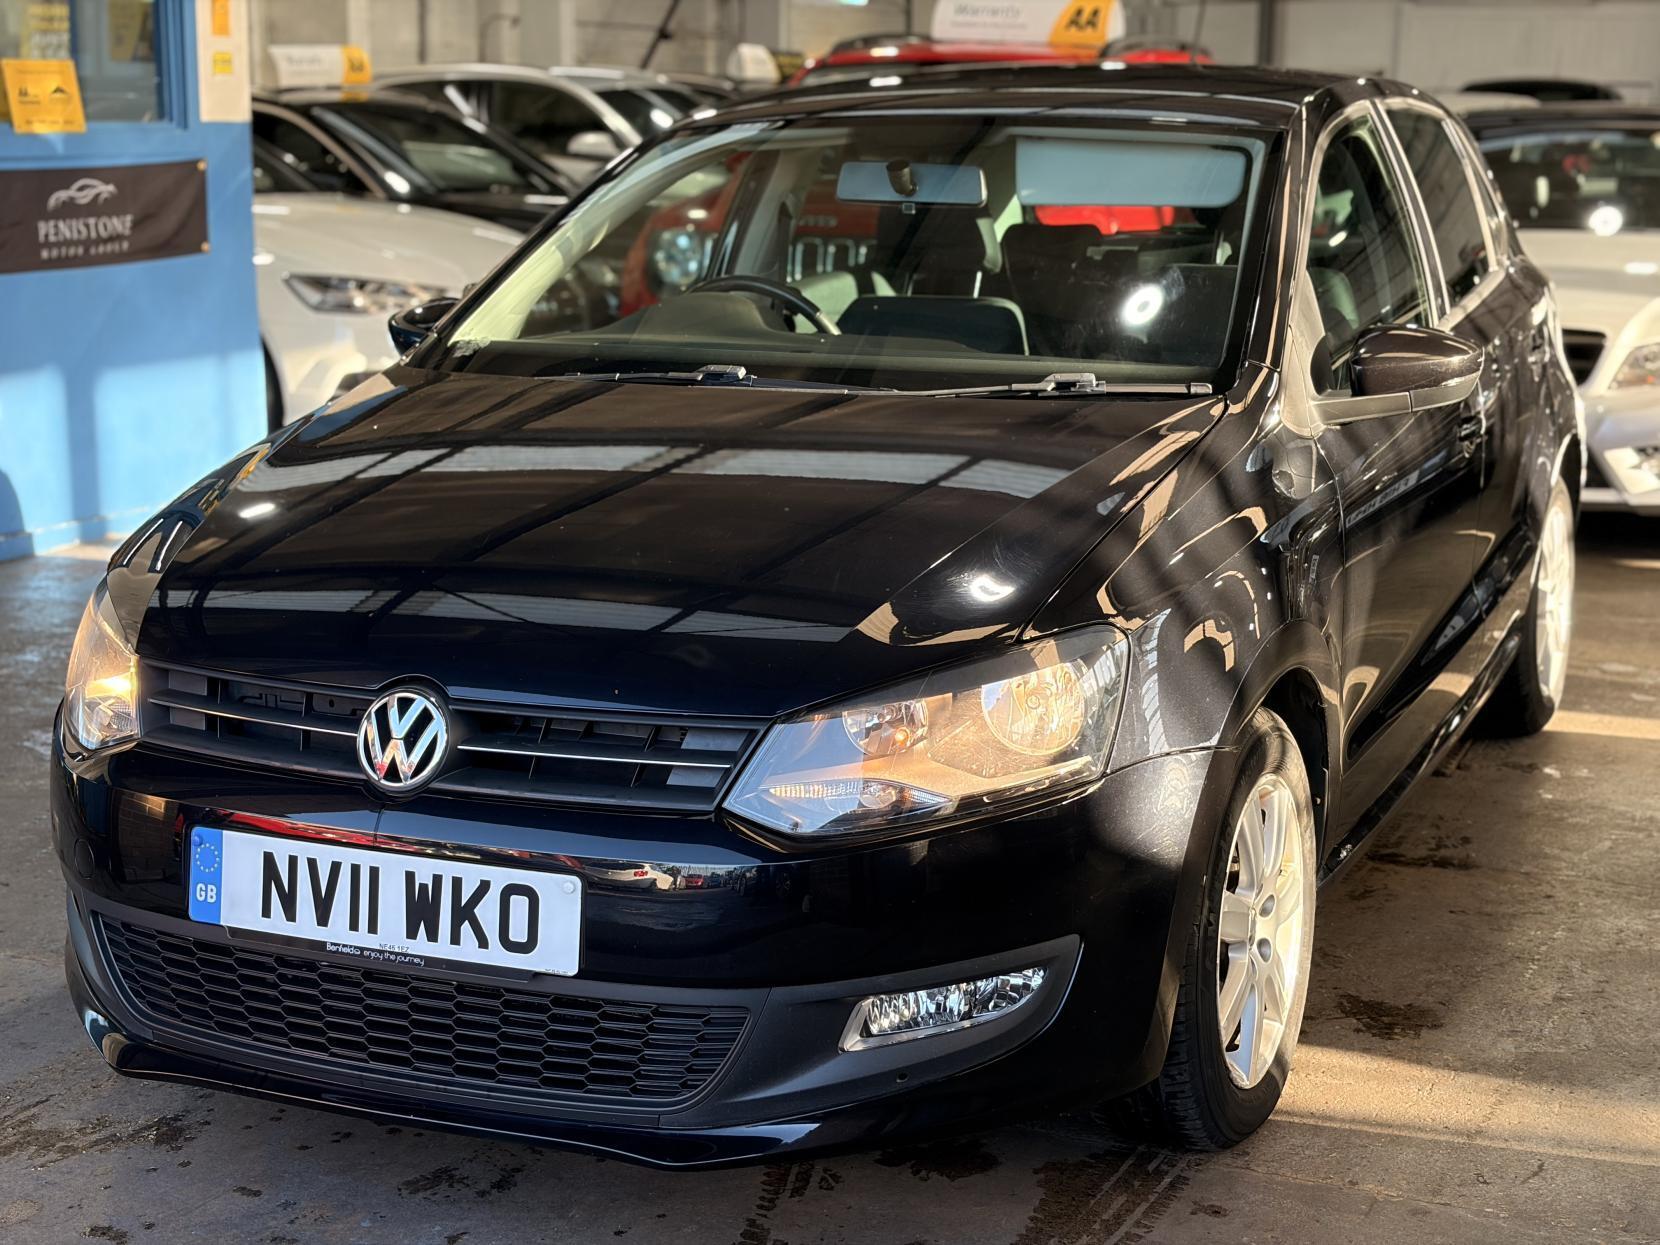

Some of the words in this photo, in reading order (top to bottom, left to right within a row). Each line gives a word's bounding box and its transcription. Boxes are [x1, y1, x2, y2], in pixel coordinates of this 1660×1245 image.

[1065, 7, 1100, 31] AA
[37, 214, 133, 242] PENISTONE
[196, 883, 217, 903] GB
[404, 870, 541, 954] WKO
[327, 942, 354, 954] Benfield
[364, 950, 383, 960] enjoy
[384, 952, 396, 960] the
[396, 954, 425, 966] journey
